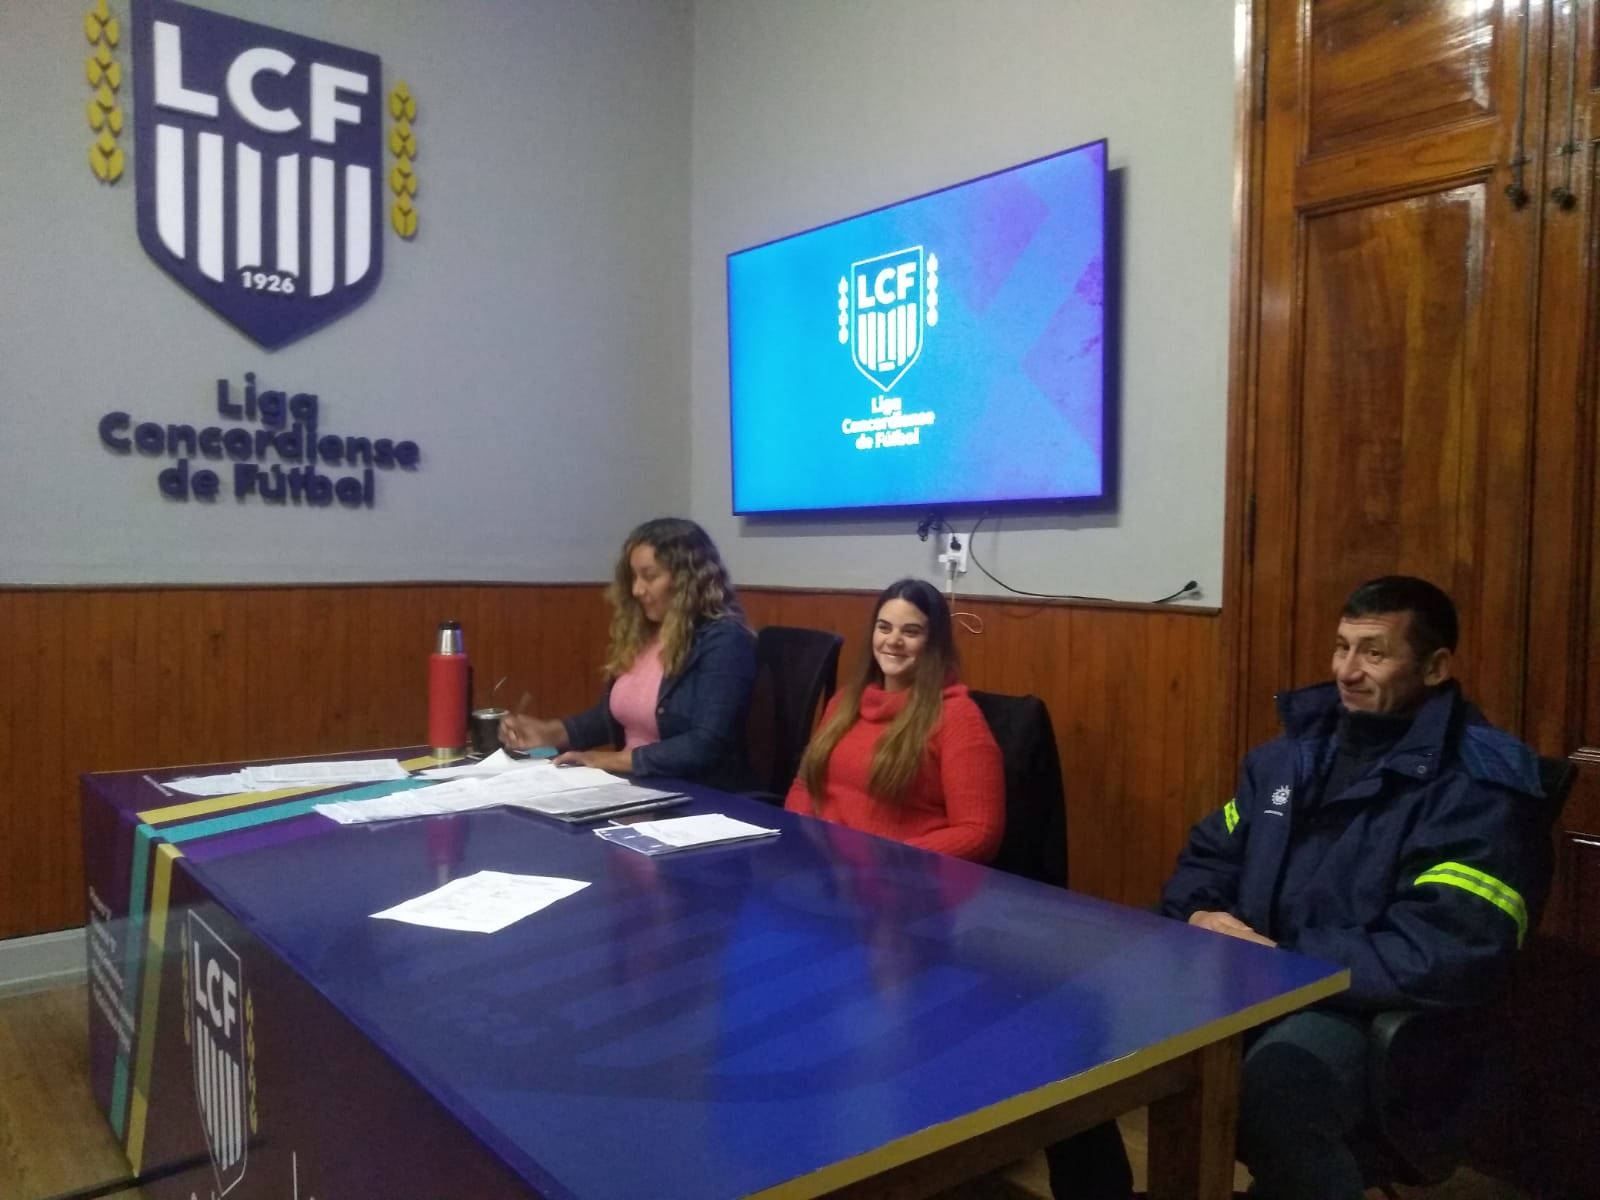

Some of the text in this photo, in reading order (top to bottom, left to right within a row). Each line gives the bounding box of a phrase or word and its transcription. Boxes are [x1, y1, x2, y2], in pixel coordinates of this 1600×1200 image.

[154, 20, 369, 143] LCF
[241, 271, 295, 293] 1926
[857, 262, 917, 309] LCF
[217, 372, 319, 430] Liga
[98, 411, 420, 471] Concordiense
[158, 458, 375, 509] de Fútbol
[193, 941, 237, 1038] LCF
